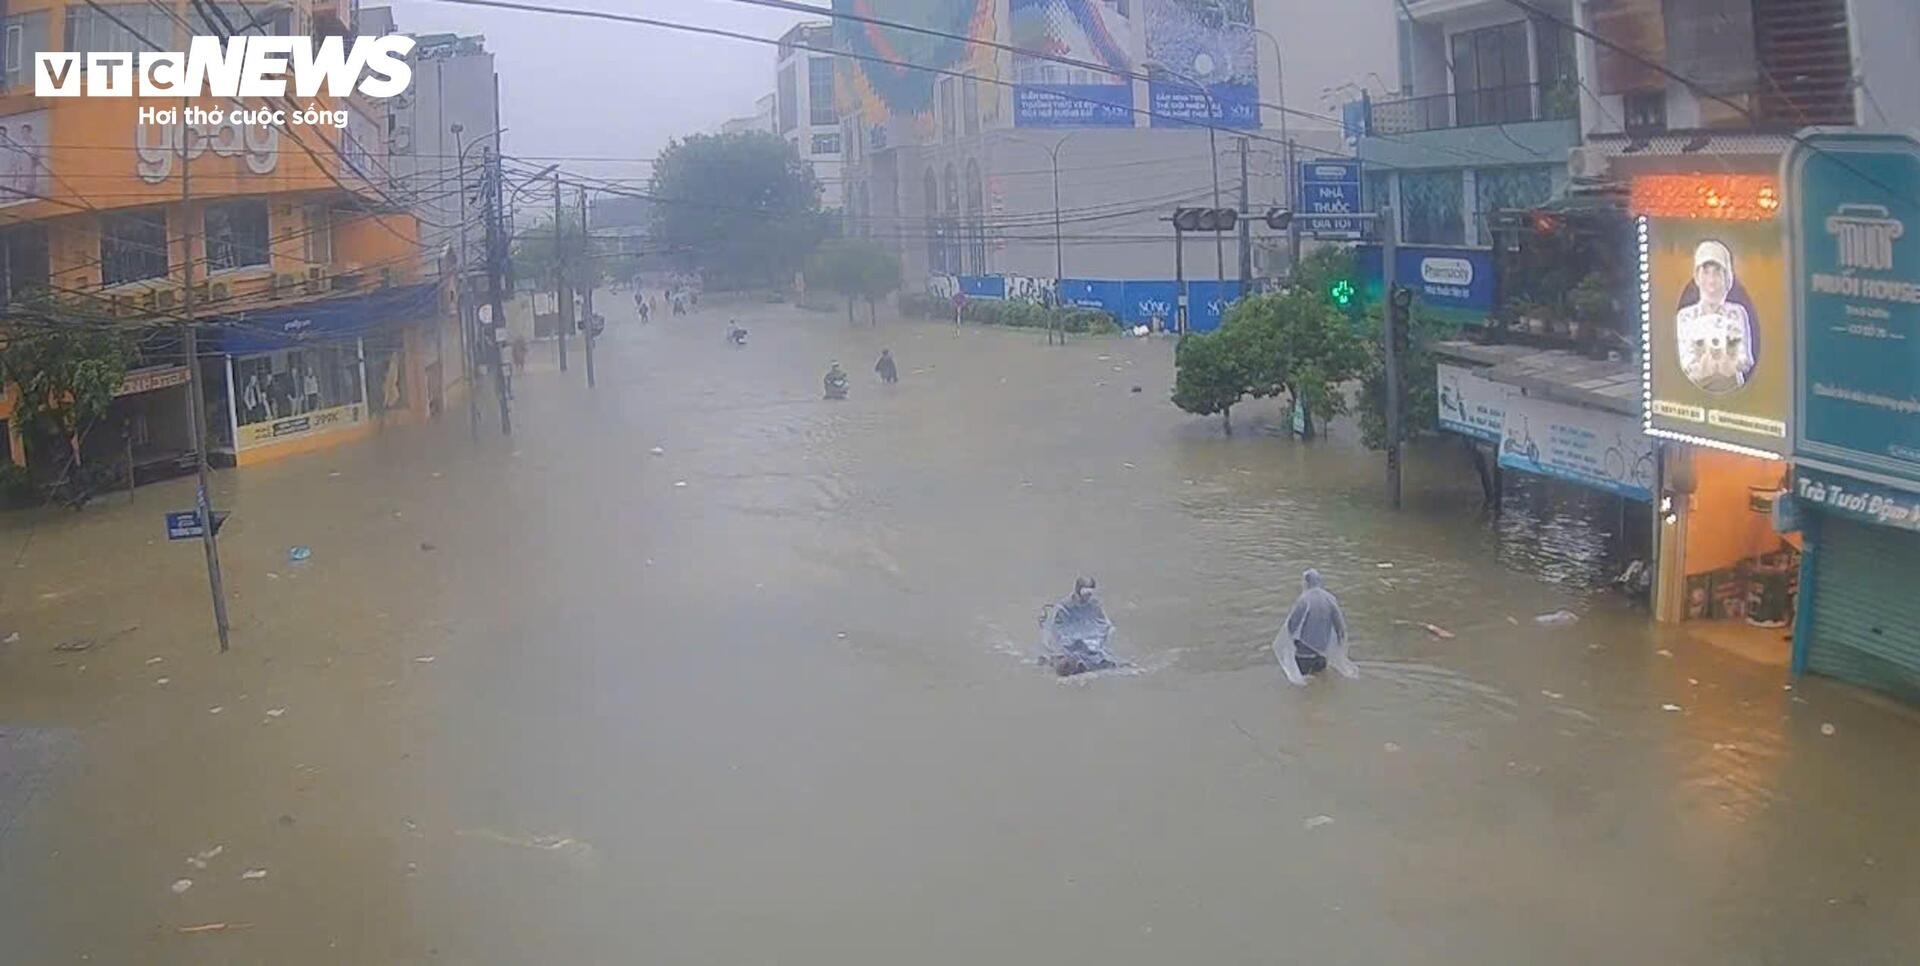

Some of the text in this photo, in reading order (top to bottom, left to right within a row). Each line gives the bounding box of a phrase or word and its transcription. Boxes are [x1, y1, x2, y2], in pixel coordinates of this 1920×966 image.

[1313, 198, 1351, 213] THUỐC
[1798, 477, 1826, 502] Trà
[1829, 485, 1869, 512] Tươi
